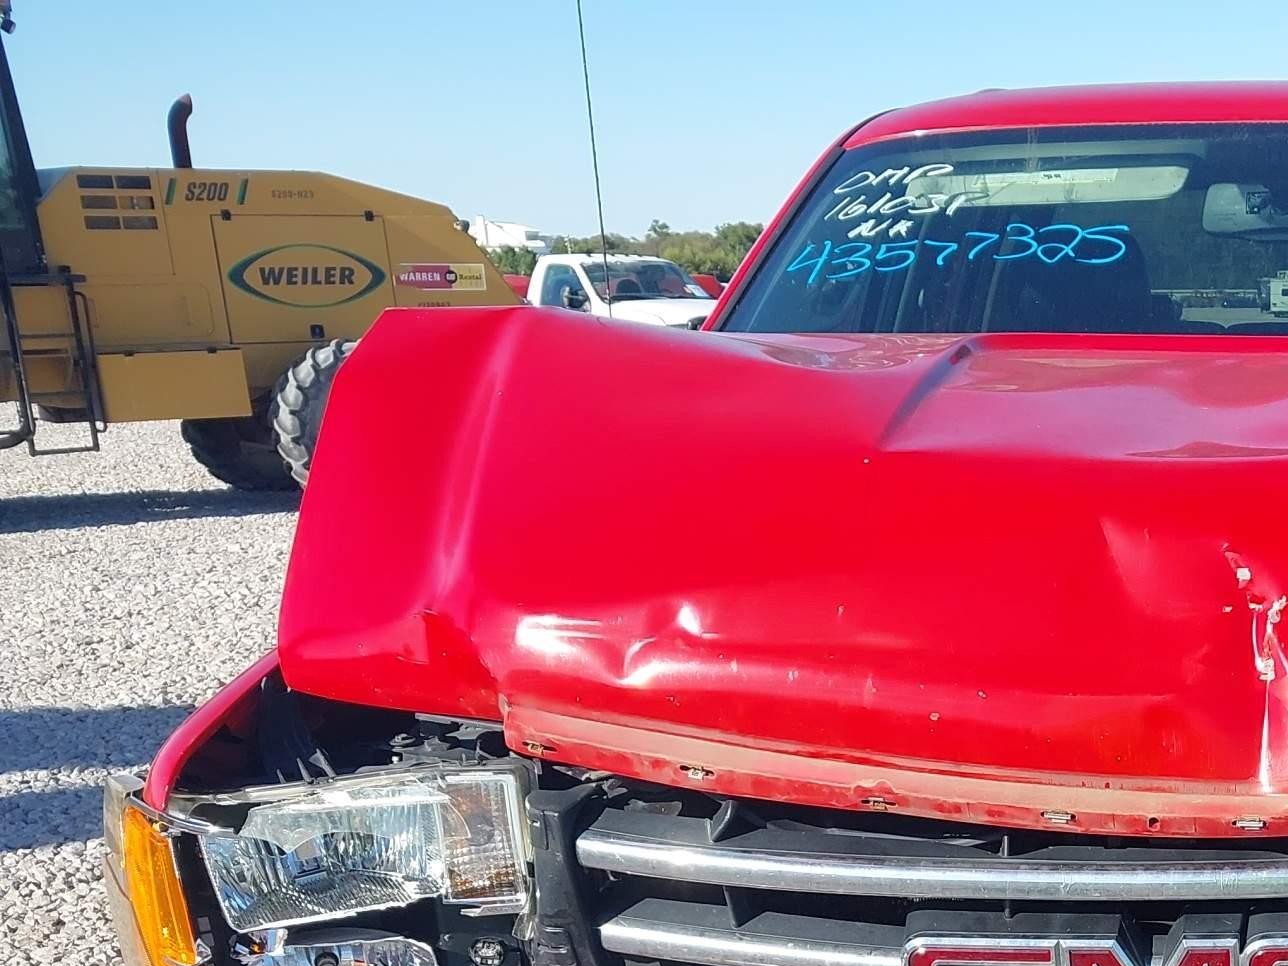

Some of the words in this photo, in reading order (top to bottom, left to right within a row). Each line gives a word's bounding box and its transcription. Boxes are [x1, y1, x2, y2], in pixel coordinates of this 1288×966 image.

[185, 181, 229, 202] S200
[785, 223, 1131, 285] 43577325
[259, 266, 355, 287] WEILER
[400, 272, 441, 282] WARREN
[458, 273, 482, 281] Rental
